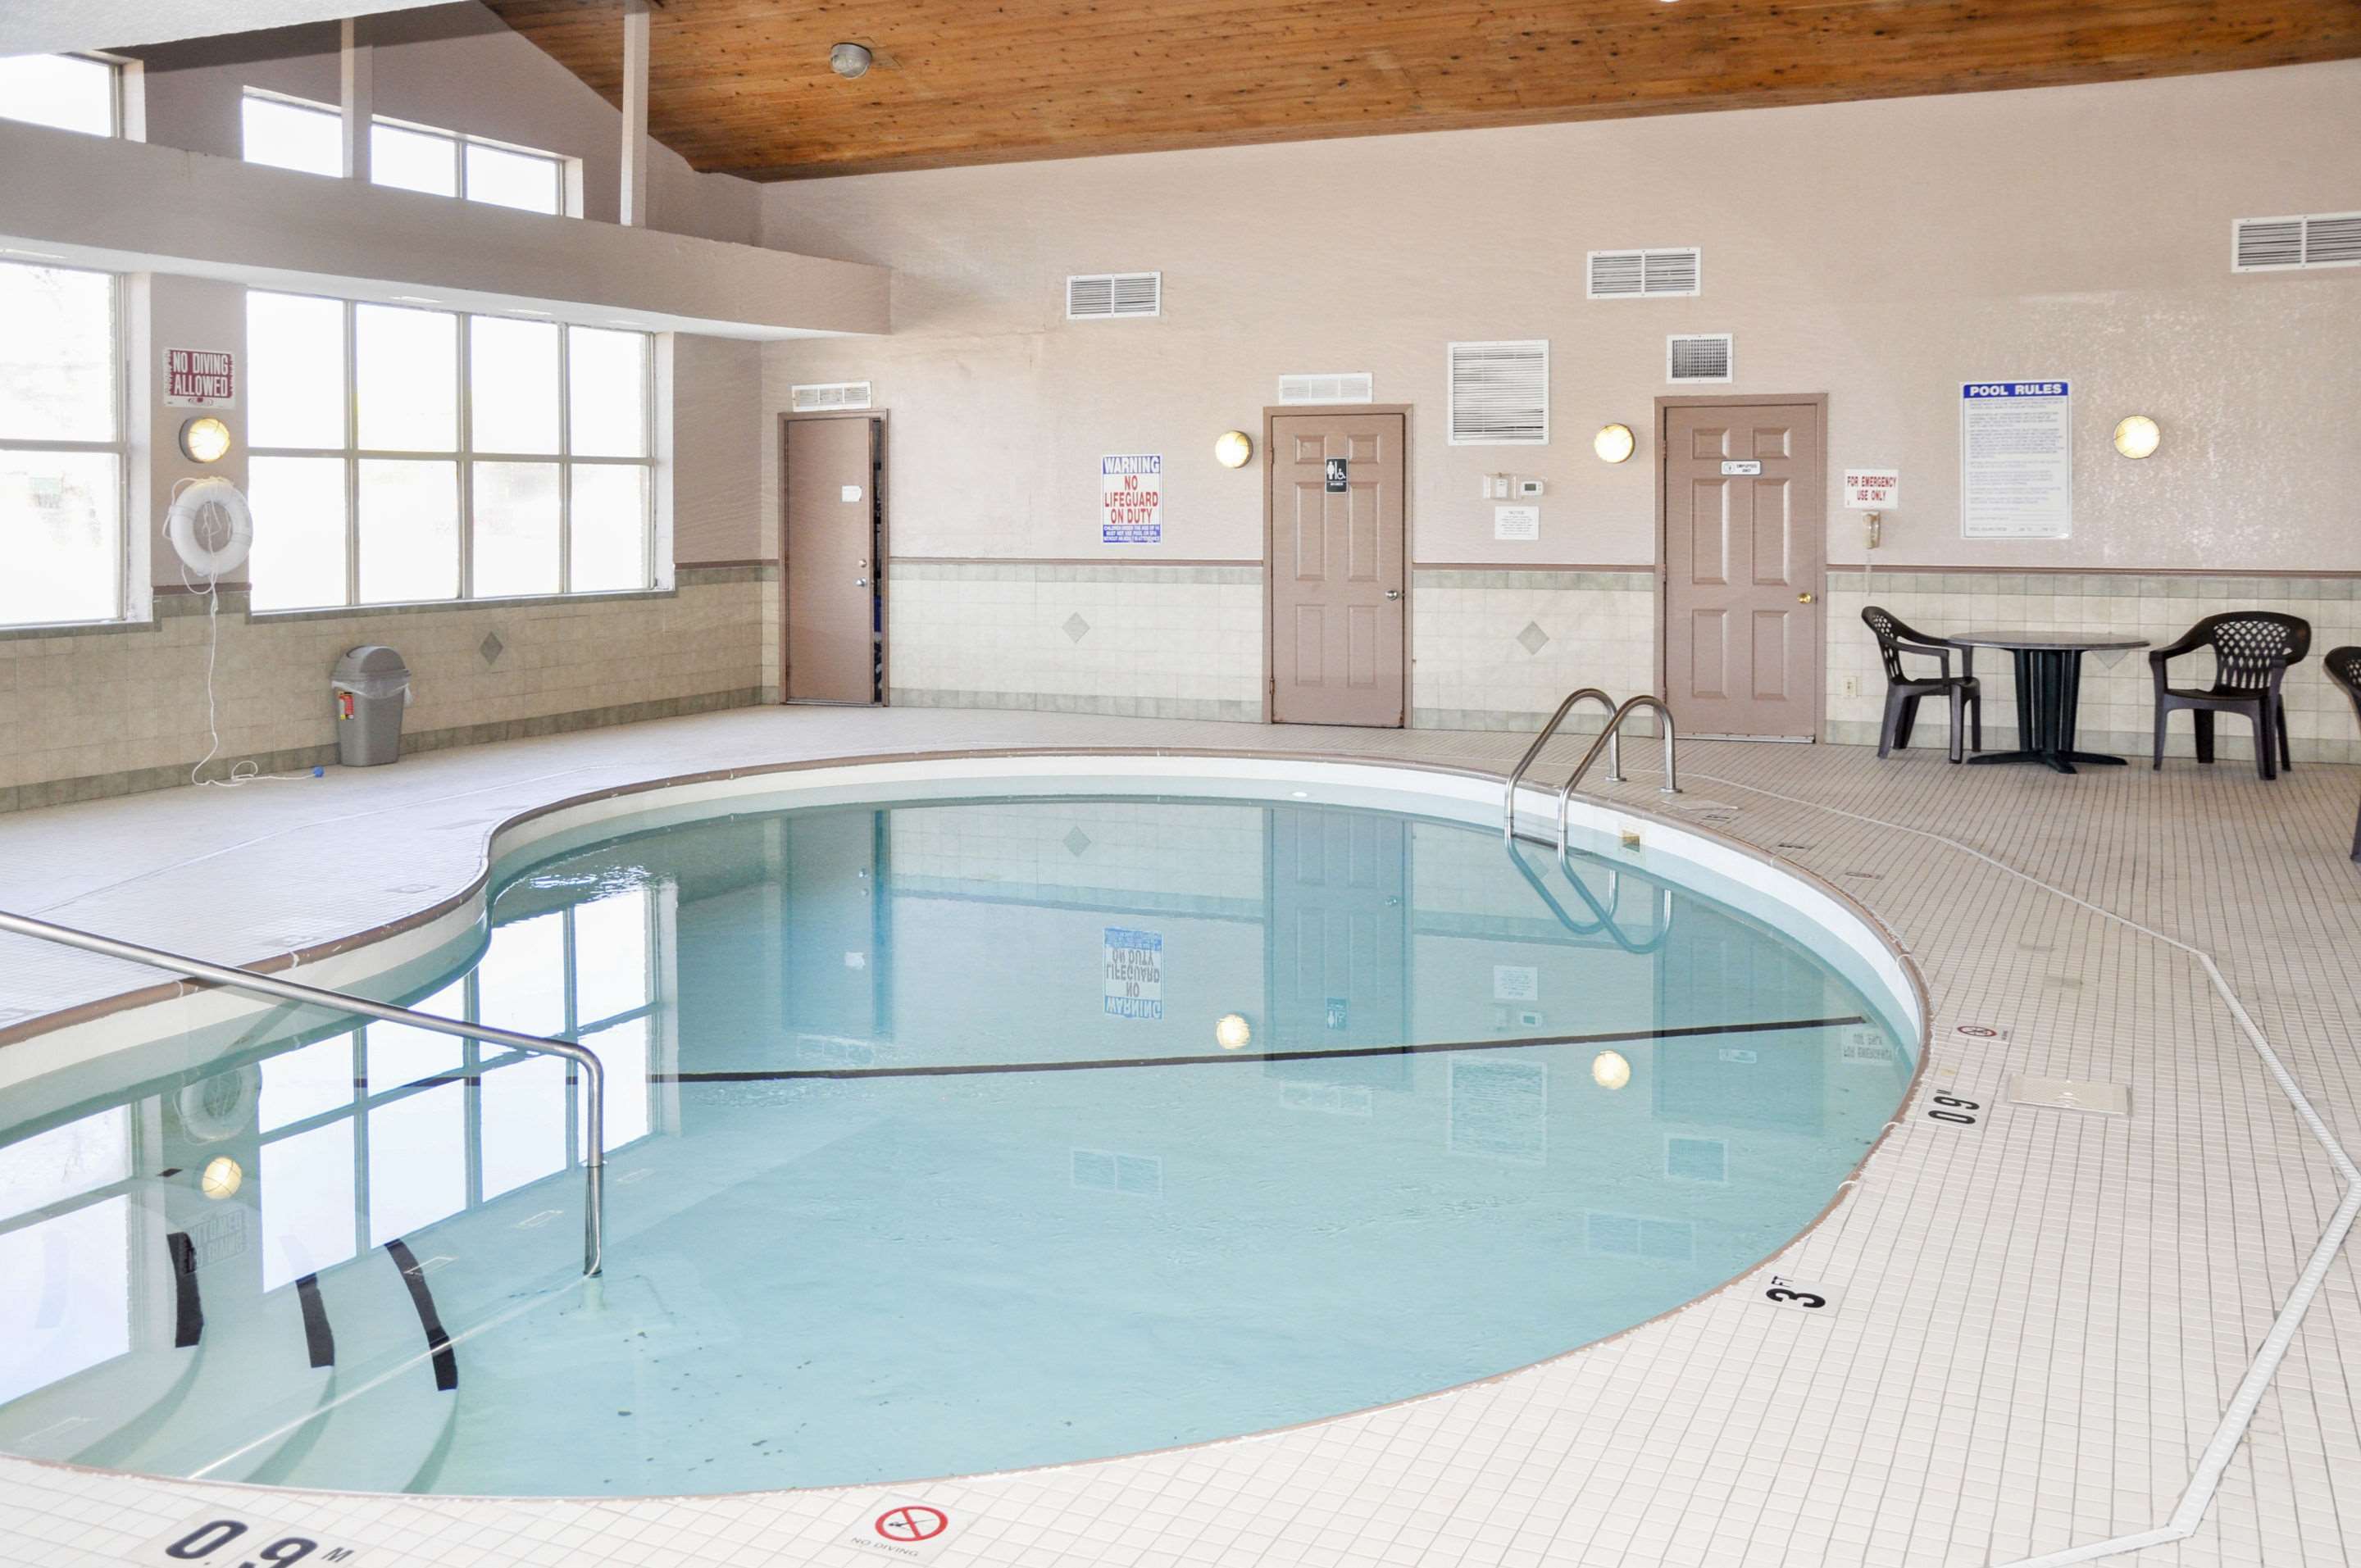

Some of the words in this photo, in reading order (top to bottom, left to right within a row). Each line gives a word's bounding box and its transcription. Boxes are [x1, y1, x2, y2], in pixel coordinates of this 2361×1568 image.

[173, 351, 188, 373] NO
[192, 352, 229, 375] DIVING
[174, 374, 228, 397] ALLOWED
[1970, 385, 2008, 396] POOL
[2015, 384, 2062, 395] RULES
[1103, 456, 1160, 474] WARNING
[1124, 475, 1138, 490] NO
[1847, 475, 1858, 486] FOR
[1862, 476, 1896, 488] EMERGENCY
[1104, 492, 1158, 507] LIFEGUARD
[1857, 490, 1868, 501] USE
[1871, 490, 1887, 501] ONLY
[1110, 508, 1124, 524] ON
[1127, 508, 1153, 524] DUTY
[1771, 1275, 1795, 1288] FT
[1766, 1288, 1826, 1309] 3
[321, 1546, 355, 1563] M
[852, 1537, 871, 1546] NO
[874, 1542, 919, 1557] DIVING
